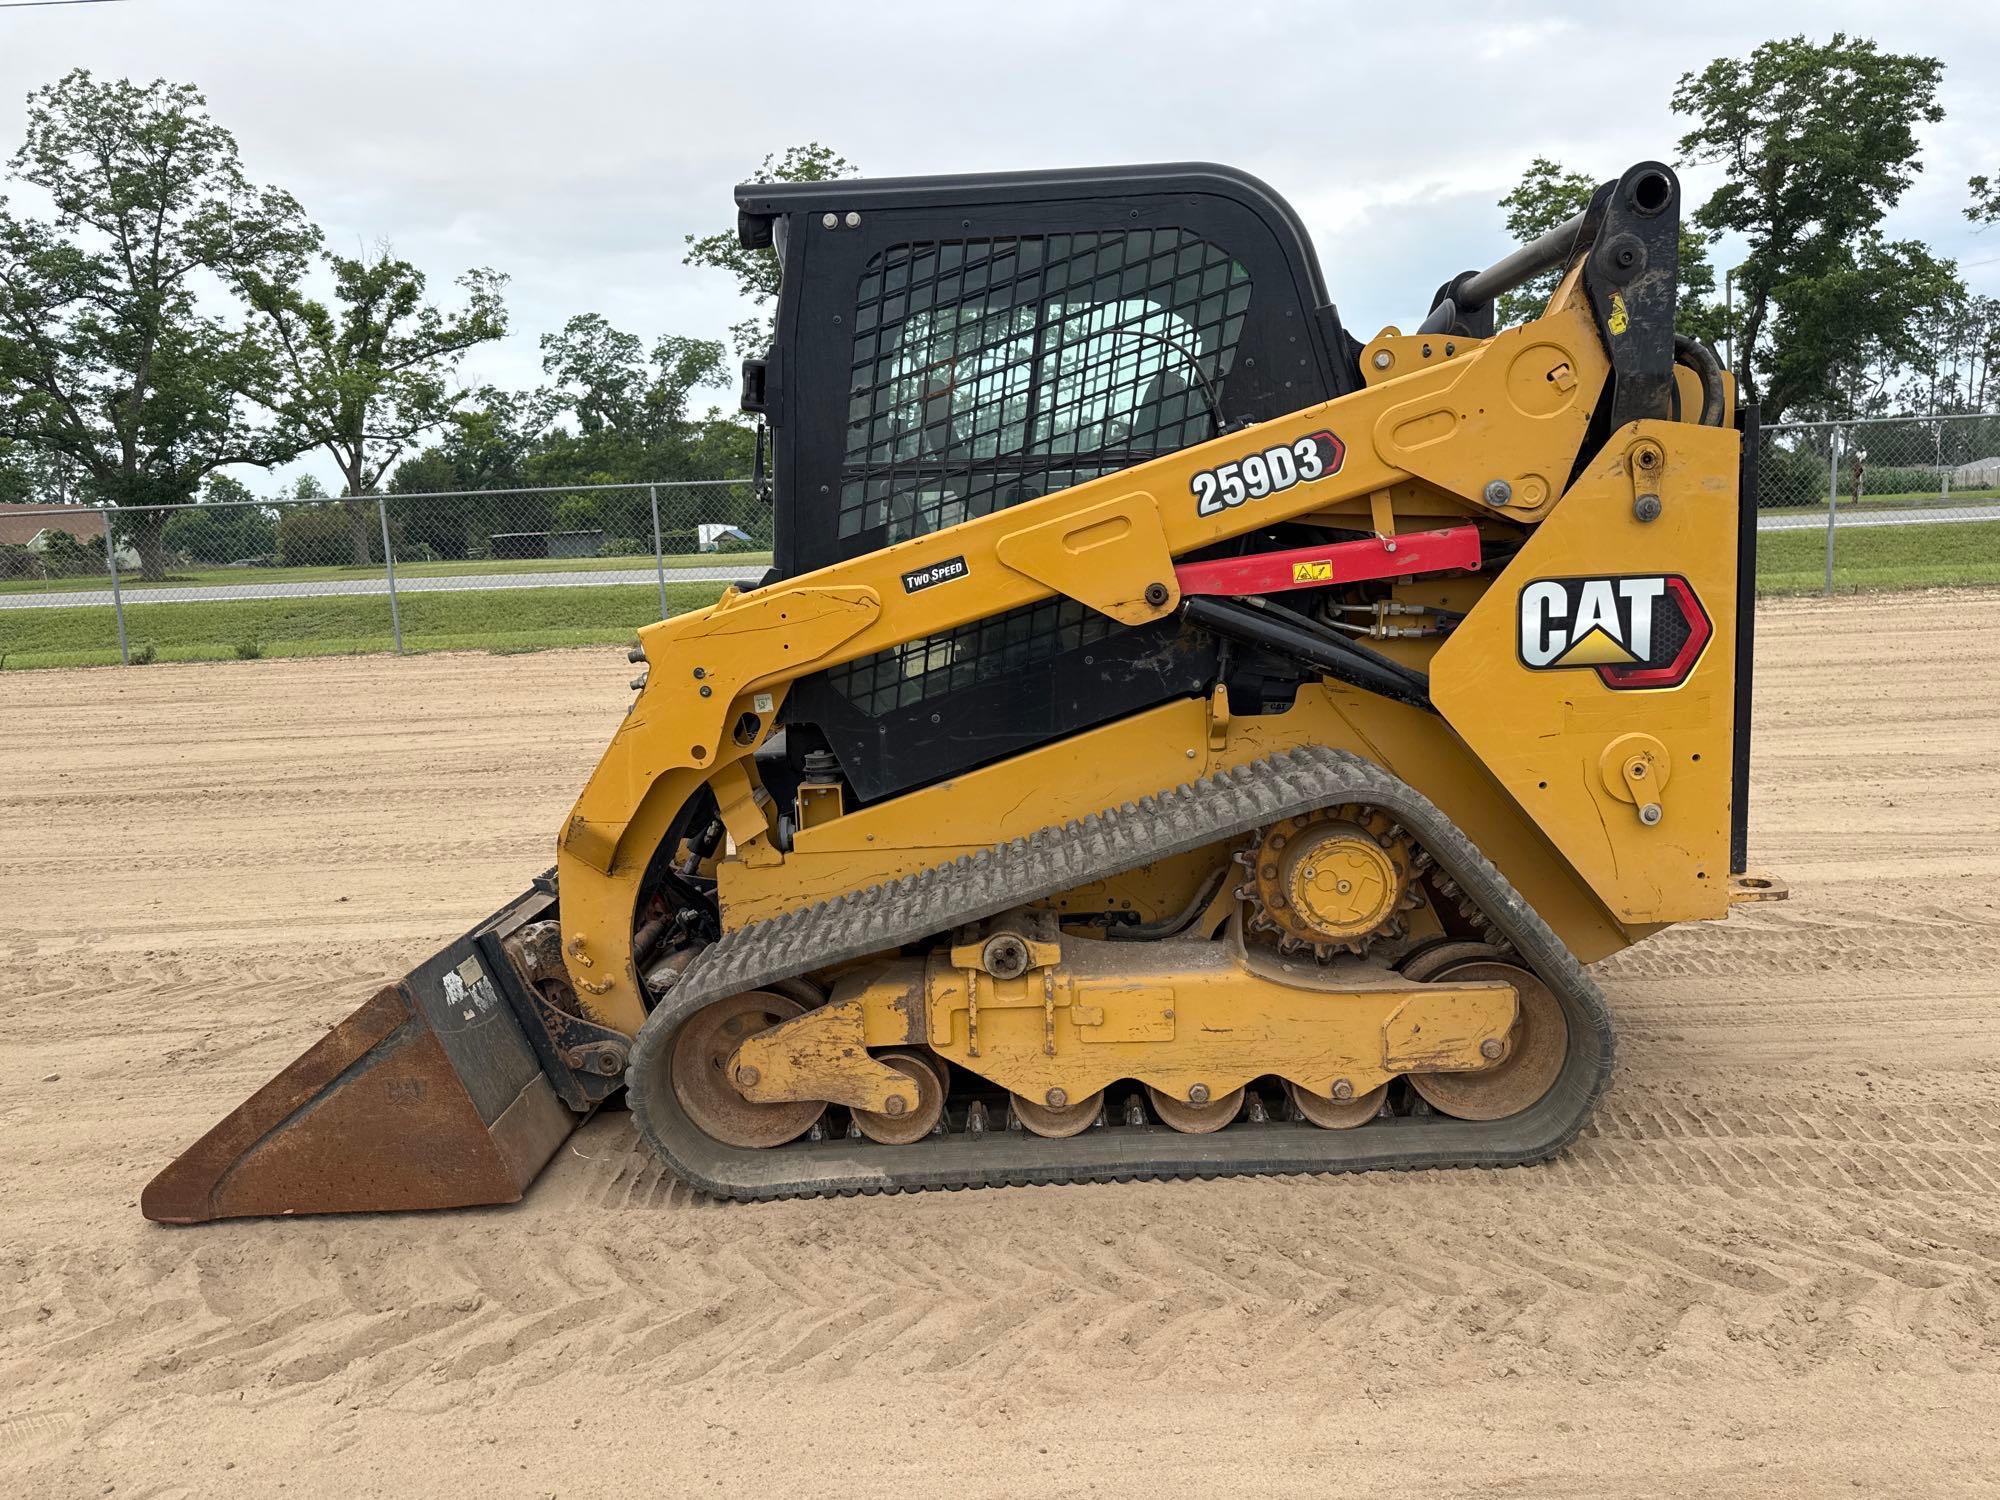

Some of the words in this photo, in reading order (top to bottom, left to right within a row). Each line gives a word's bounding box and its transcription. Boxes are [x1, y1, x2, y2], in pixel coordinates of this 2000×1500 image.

[1192, 438, 1323, 515] 259D3
[906, 573, 930, 589] TWO
[931, 562, 963, 581] SPEED
[1522, 577, 1665, 666] CAT
